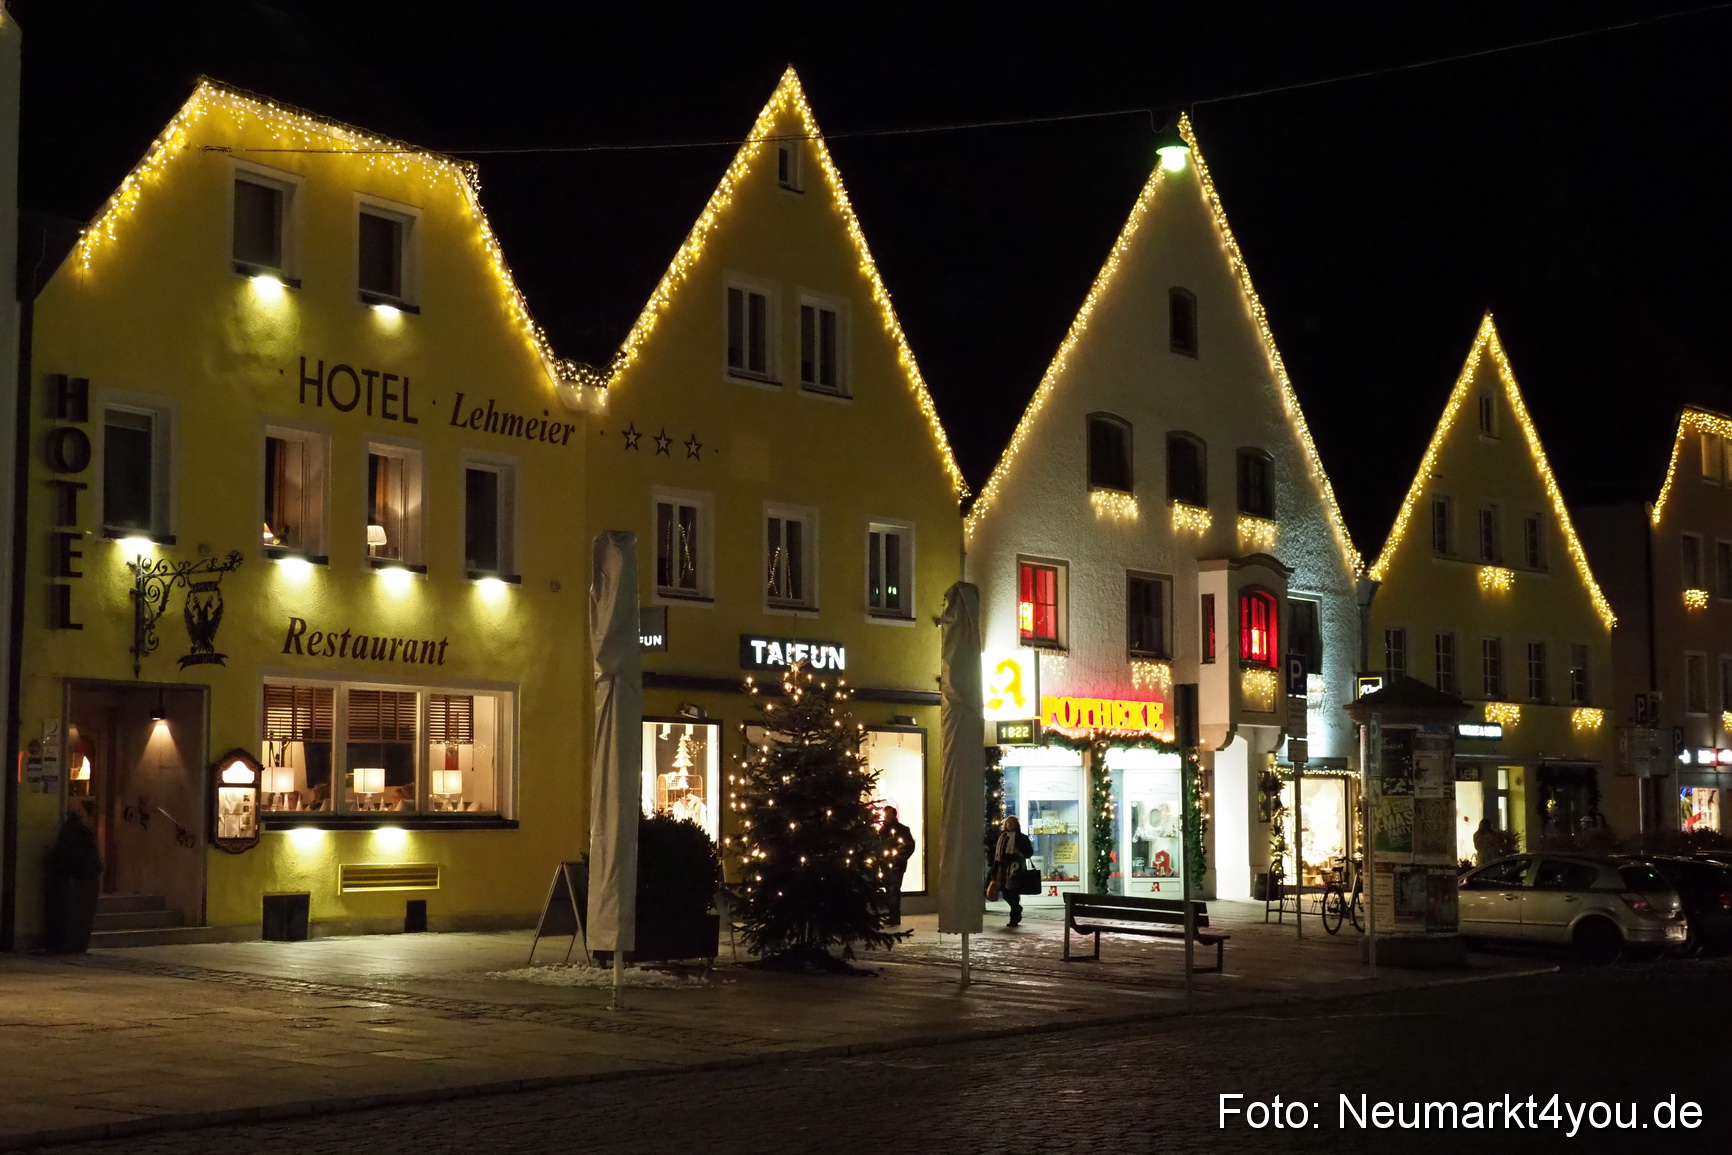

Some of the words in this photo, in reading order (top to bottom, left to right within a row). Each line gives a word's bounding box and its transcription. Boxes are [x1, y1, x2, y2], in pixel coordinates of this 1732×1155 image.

[301, 357, 418, 424] HOTEL
[450, 391, 575, 446] Lehmeier
[50, 374, 91, 631] HOTEL
[282, 616, 448, 665] Restaurant
[750, 639, 845, 670] TAIFUN
[1290, 660, 1303, 690] P
[1637, 696, 1645, 720] P
